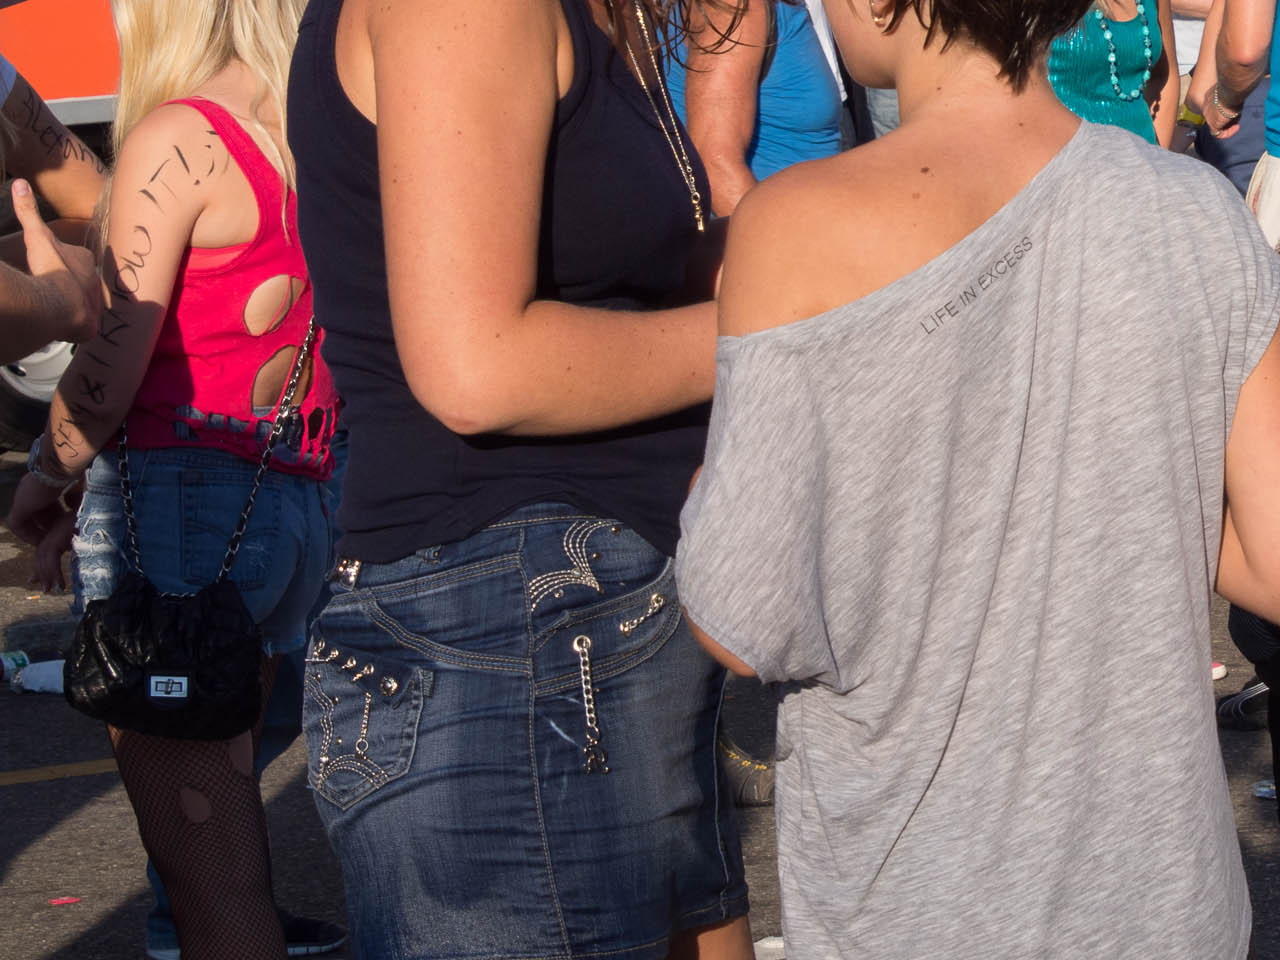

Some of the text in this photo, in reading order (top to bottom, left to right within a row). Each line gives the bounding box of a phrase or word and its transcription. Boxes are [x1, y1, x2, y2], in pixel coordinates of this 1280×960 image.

[920, 236, 1033, 335] LIFE IN EXCESS
